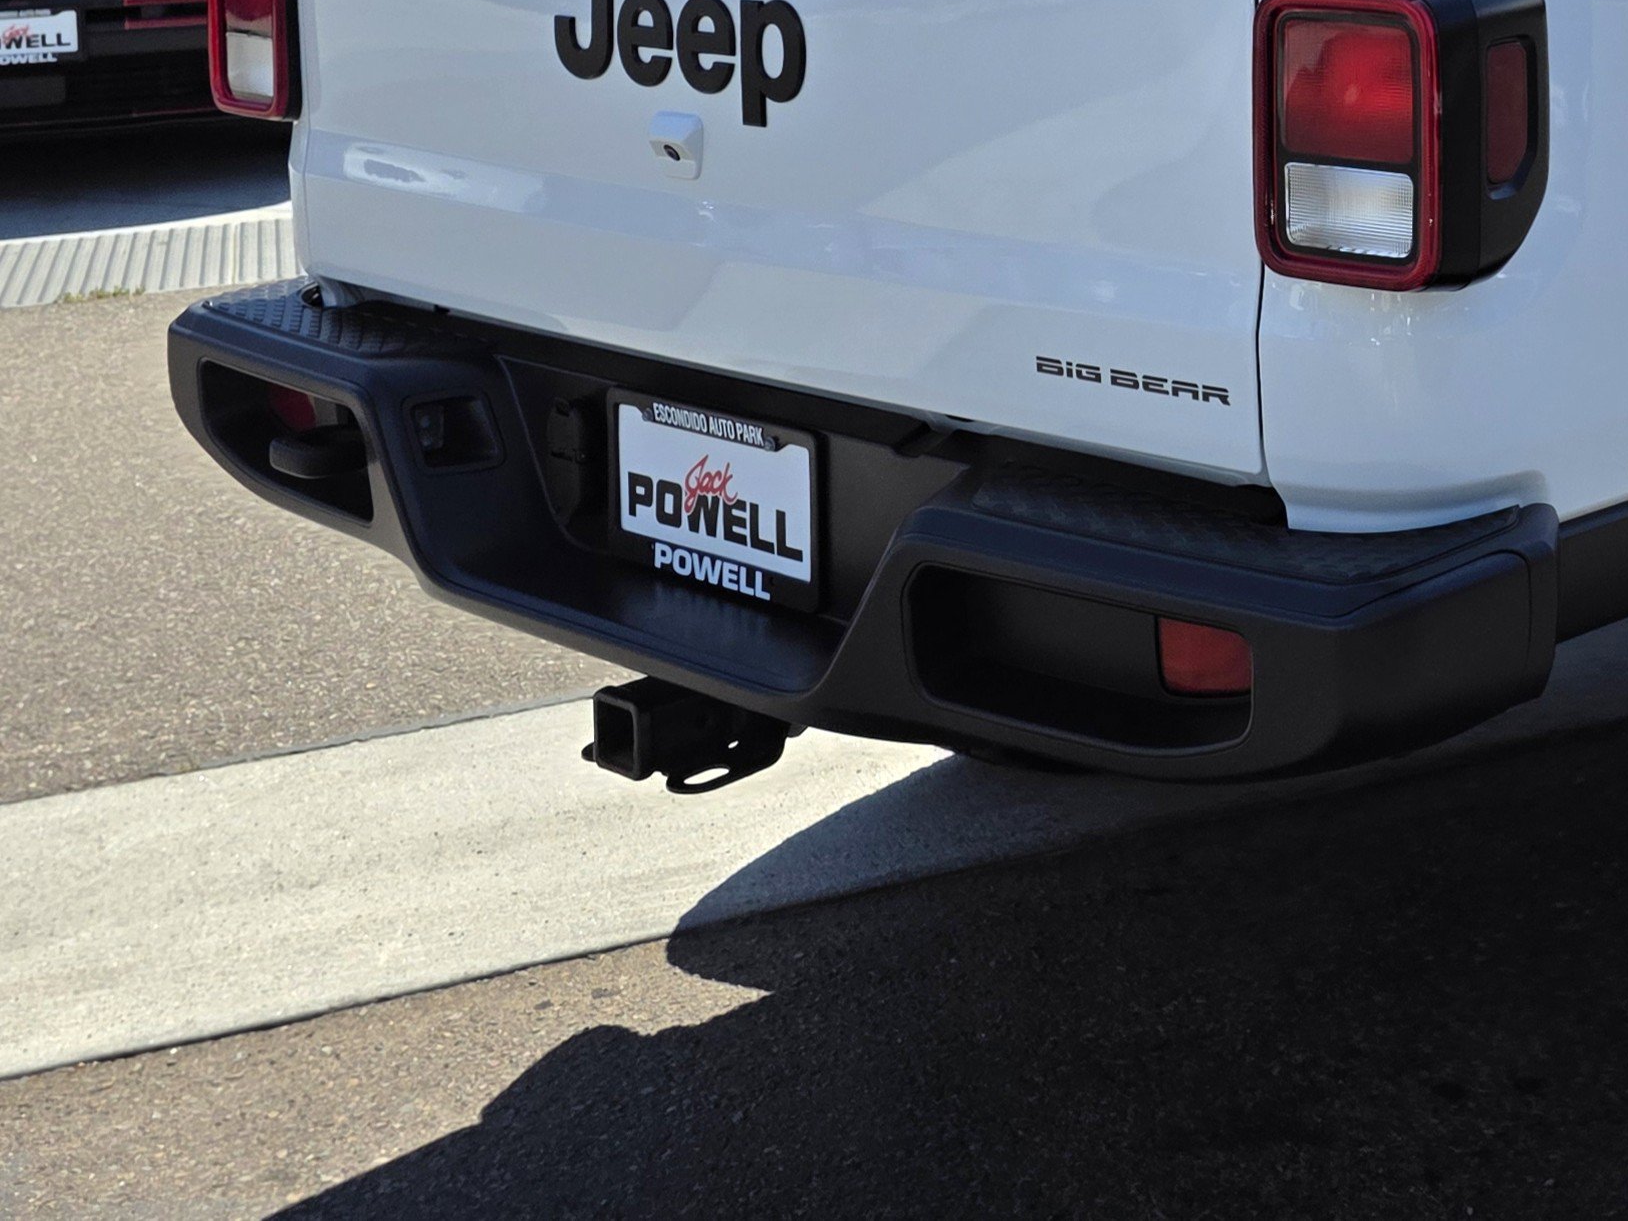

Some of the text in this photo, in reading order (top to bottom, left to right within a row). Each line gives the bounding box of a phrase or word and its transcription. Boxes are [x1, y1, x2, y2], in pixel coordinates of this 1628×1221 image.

[1036, 355, 1231, 406] BIG BEAR
[652, 402, 764, 447] ESCONDIDO AUTO PARK
[684, 454, 738, 513] Jack
[628, 471, 803, 563] POWELL
[654, 542, 771, 601] POWELL
